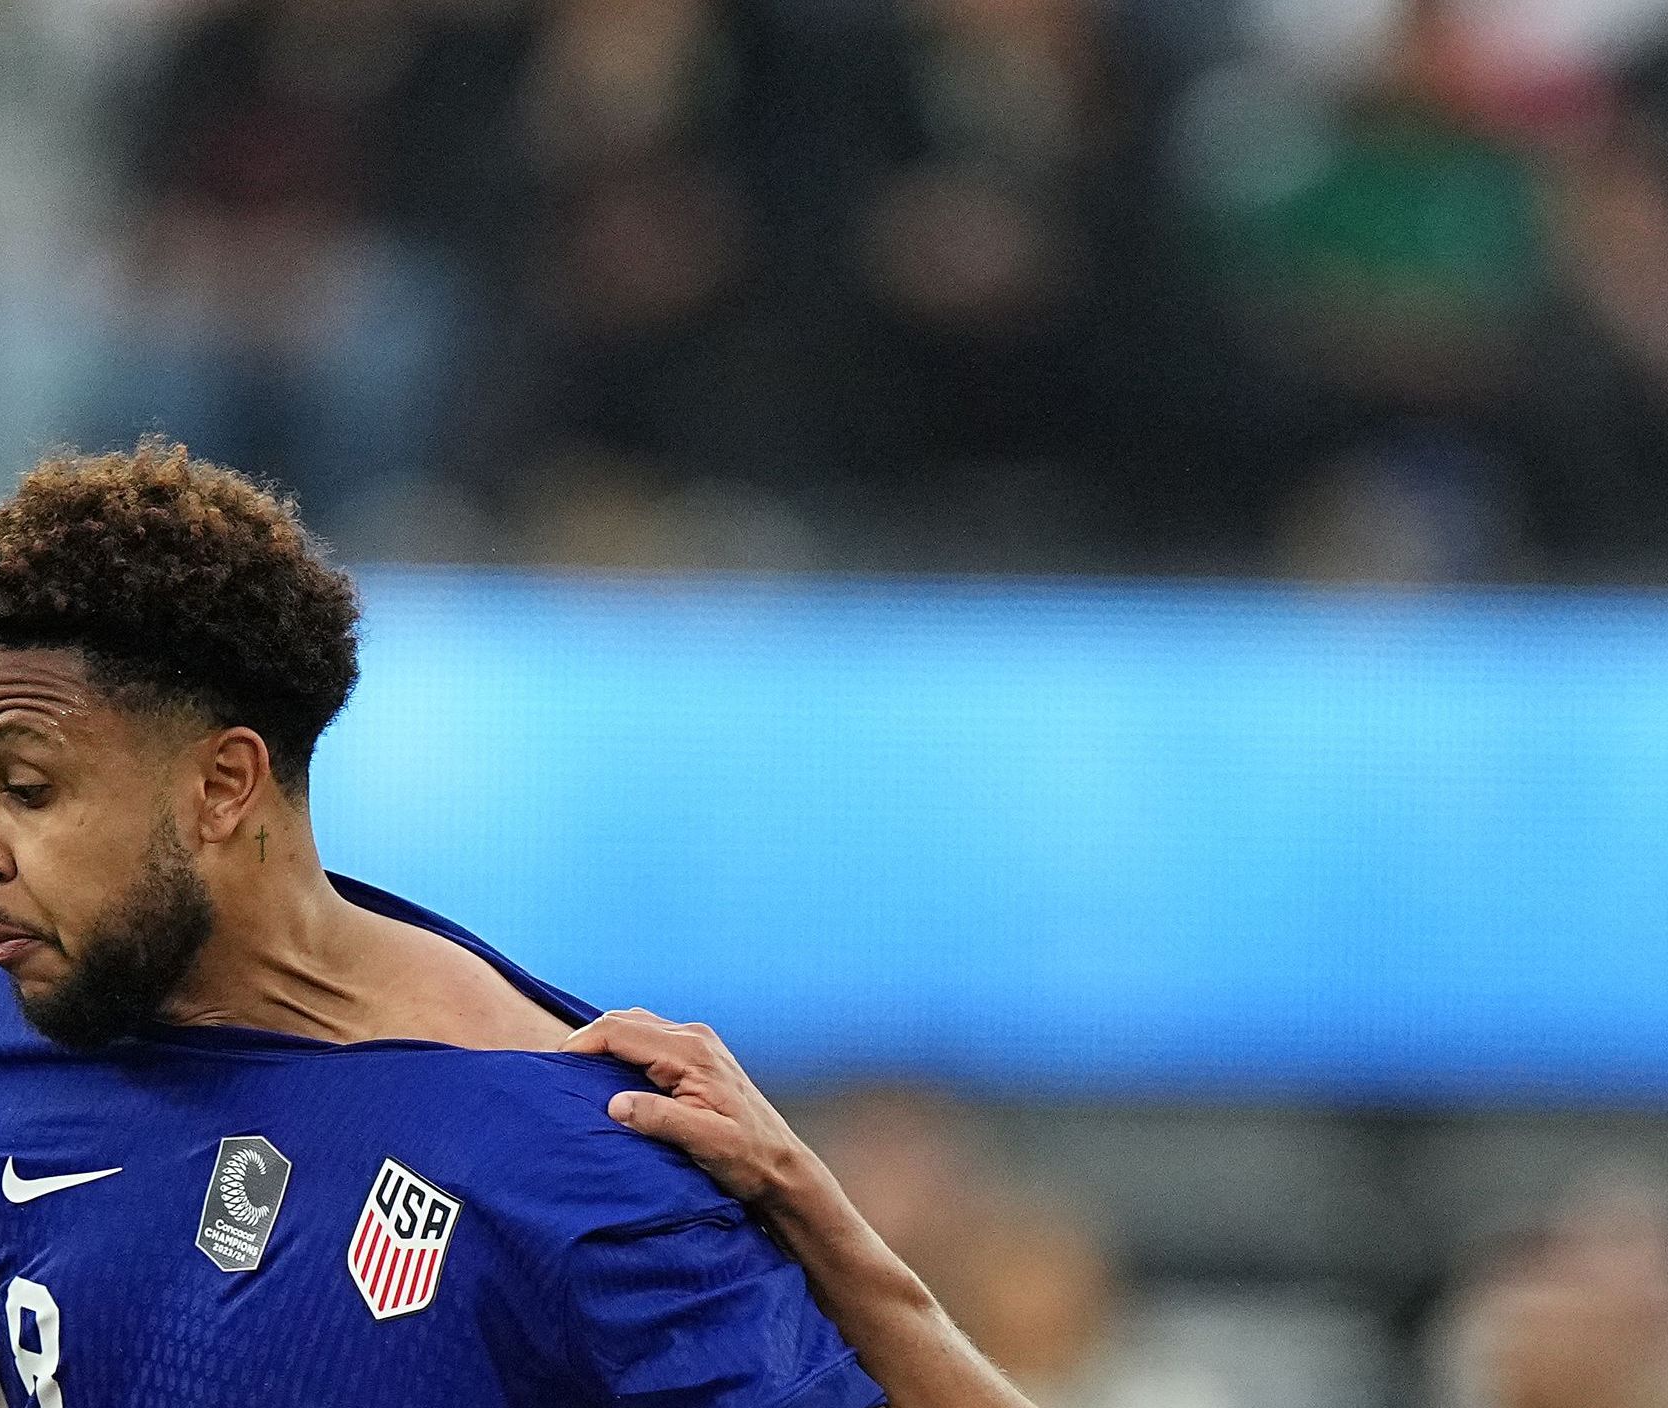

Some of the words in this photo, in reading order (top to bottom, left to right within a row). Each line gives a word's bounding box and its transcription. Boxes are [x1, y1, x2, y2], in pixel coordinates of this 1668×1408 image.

[375, 1168, 452, 1240] USA
[204, 1227, 260, 1257] CHAMPIONS
[212, 1242, 246, 1262] 2023/24
